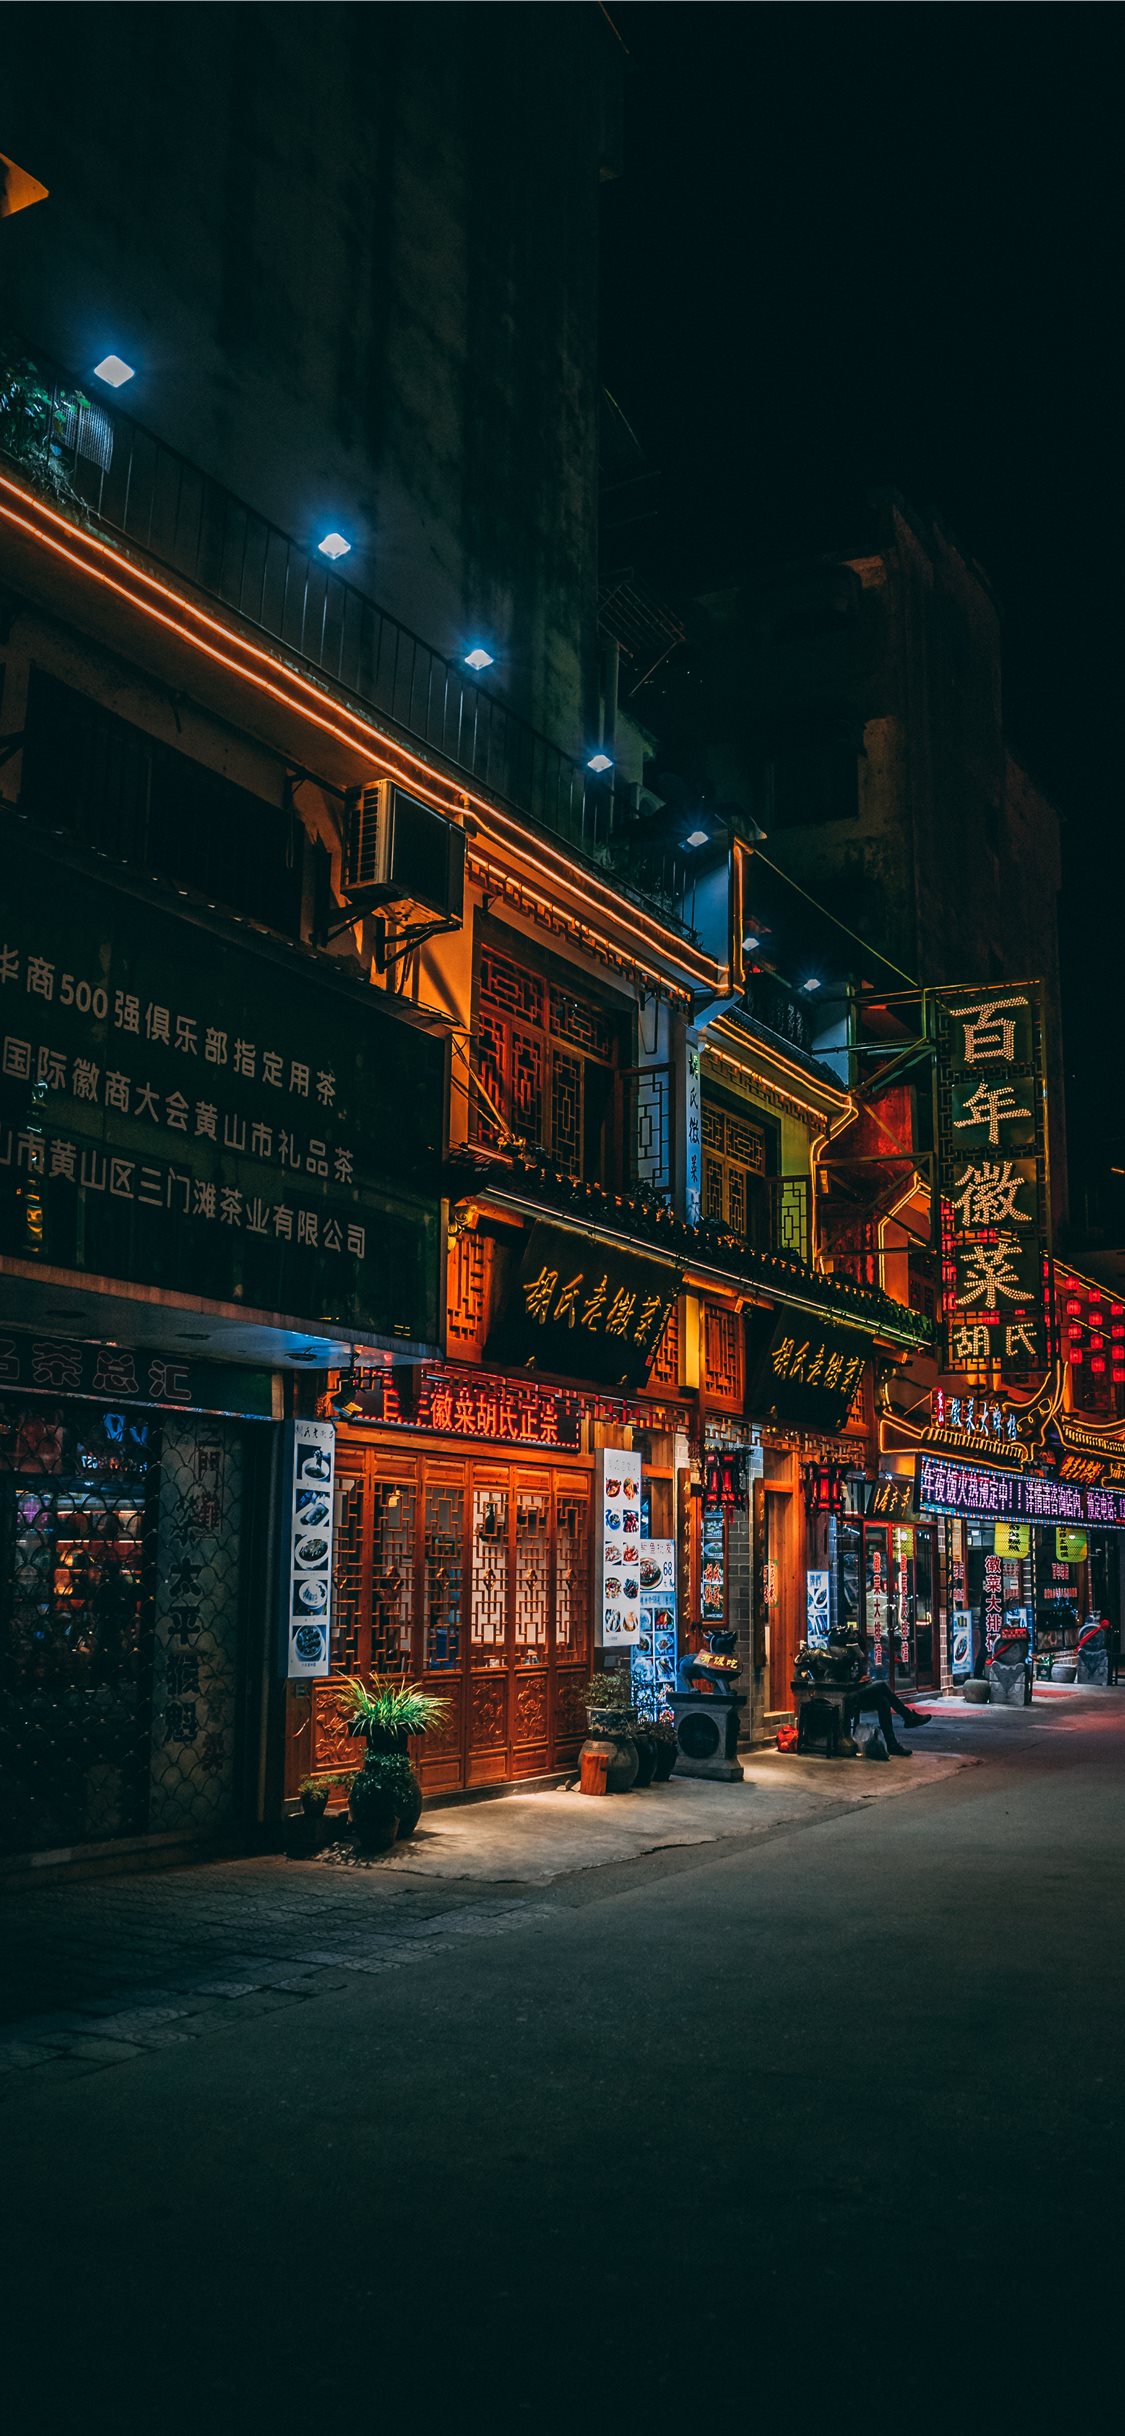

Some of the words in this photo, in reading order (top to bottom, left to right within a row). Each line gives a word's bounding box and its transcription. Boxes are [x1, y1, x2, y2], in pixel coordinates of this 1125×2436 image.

[0, 944, 337, 1107] 华商500强俱乐部指定用茶
[2, 1035, 355, 1185] 国际徽商大会黄山市礼品茶
[950, 996, 1035, 1310] 百年徽菜
[953, 1322, 1037, 1357] 胡氏
[663, 1561, 673, 1576] 68
